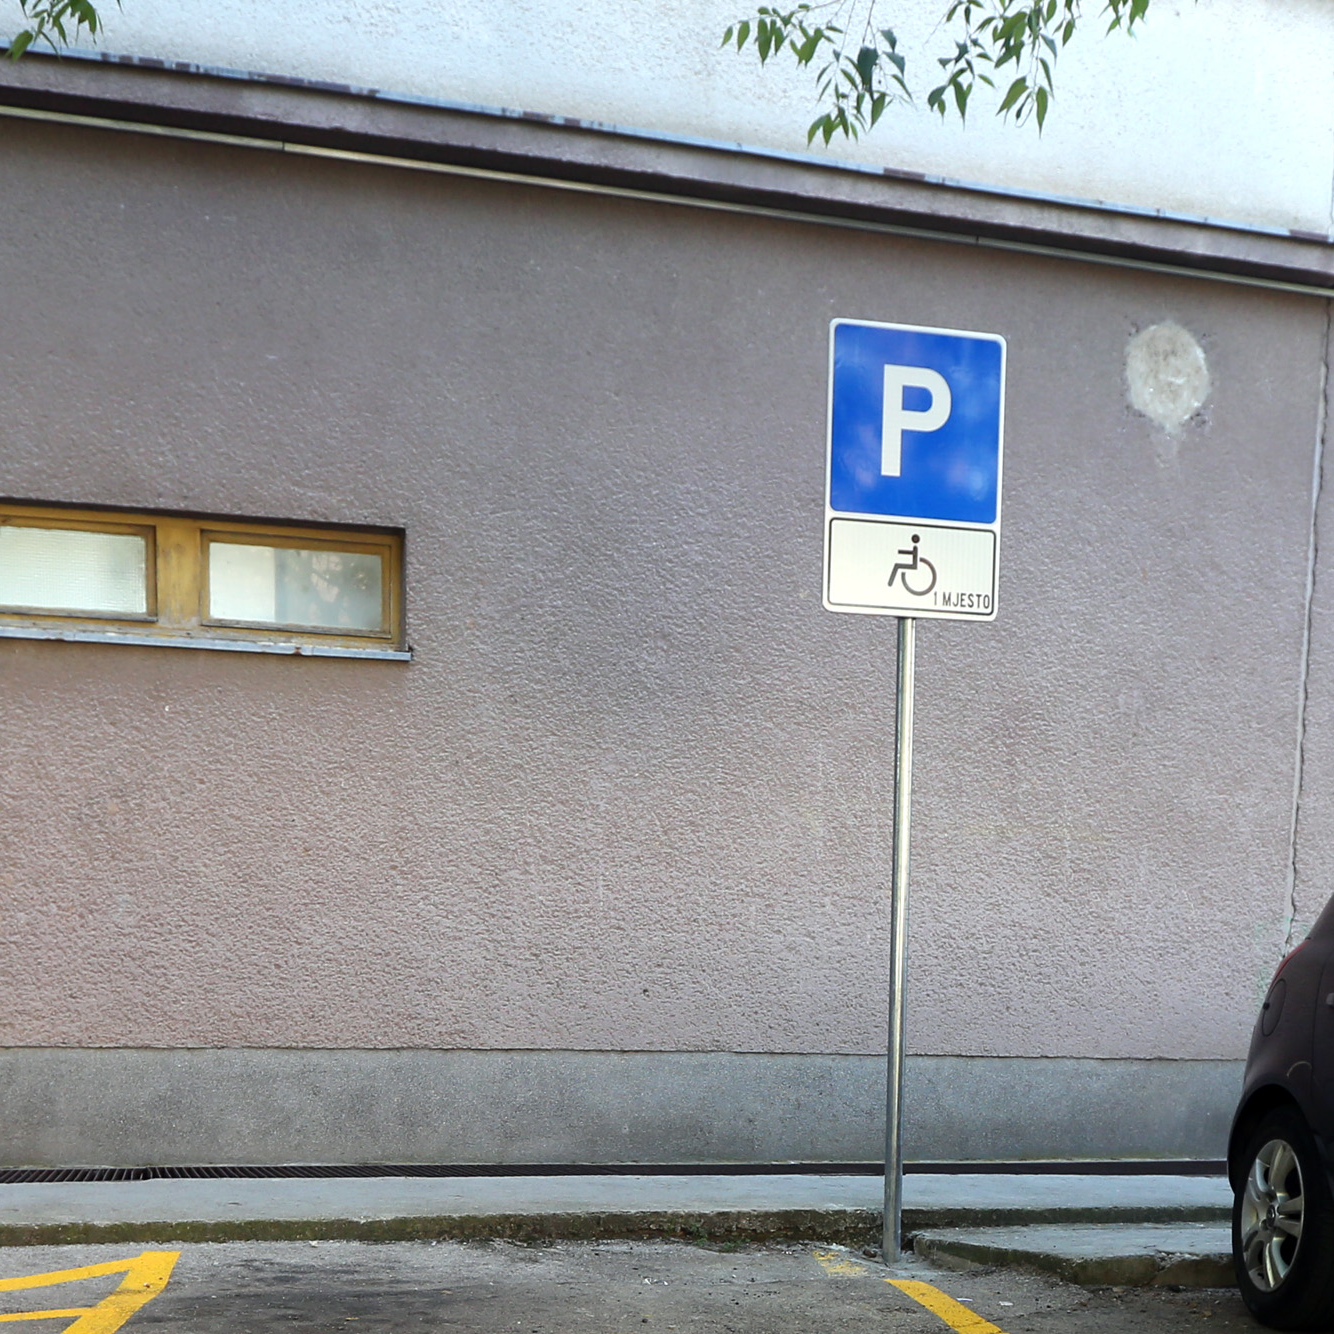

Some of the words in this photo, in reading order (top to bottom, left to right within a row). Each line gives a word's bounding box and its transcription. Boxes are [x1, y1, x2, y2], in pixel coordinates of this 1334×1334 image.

[880, 364, 952, 477] P
[933, 591, 938, 606] 1
[942, 592, 990, 609] MJESTO
